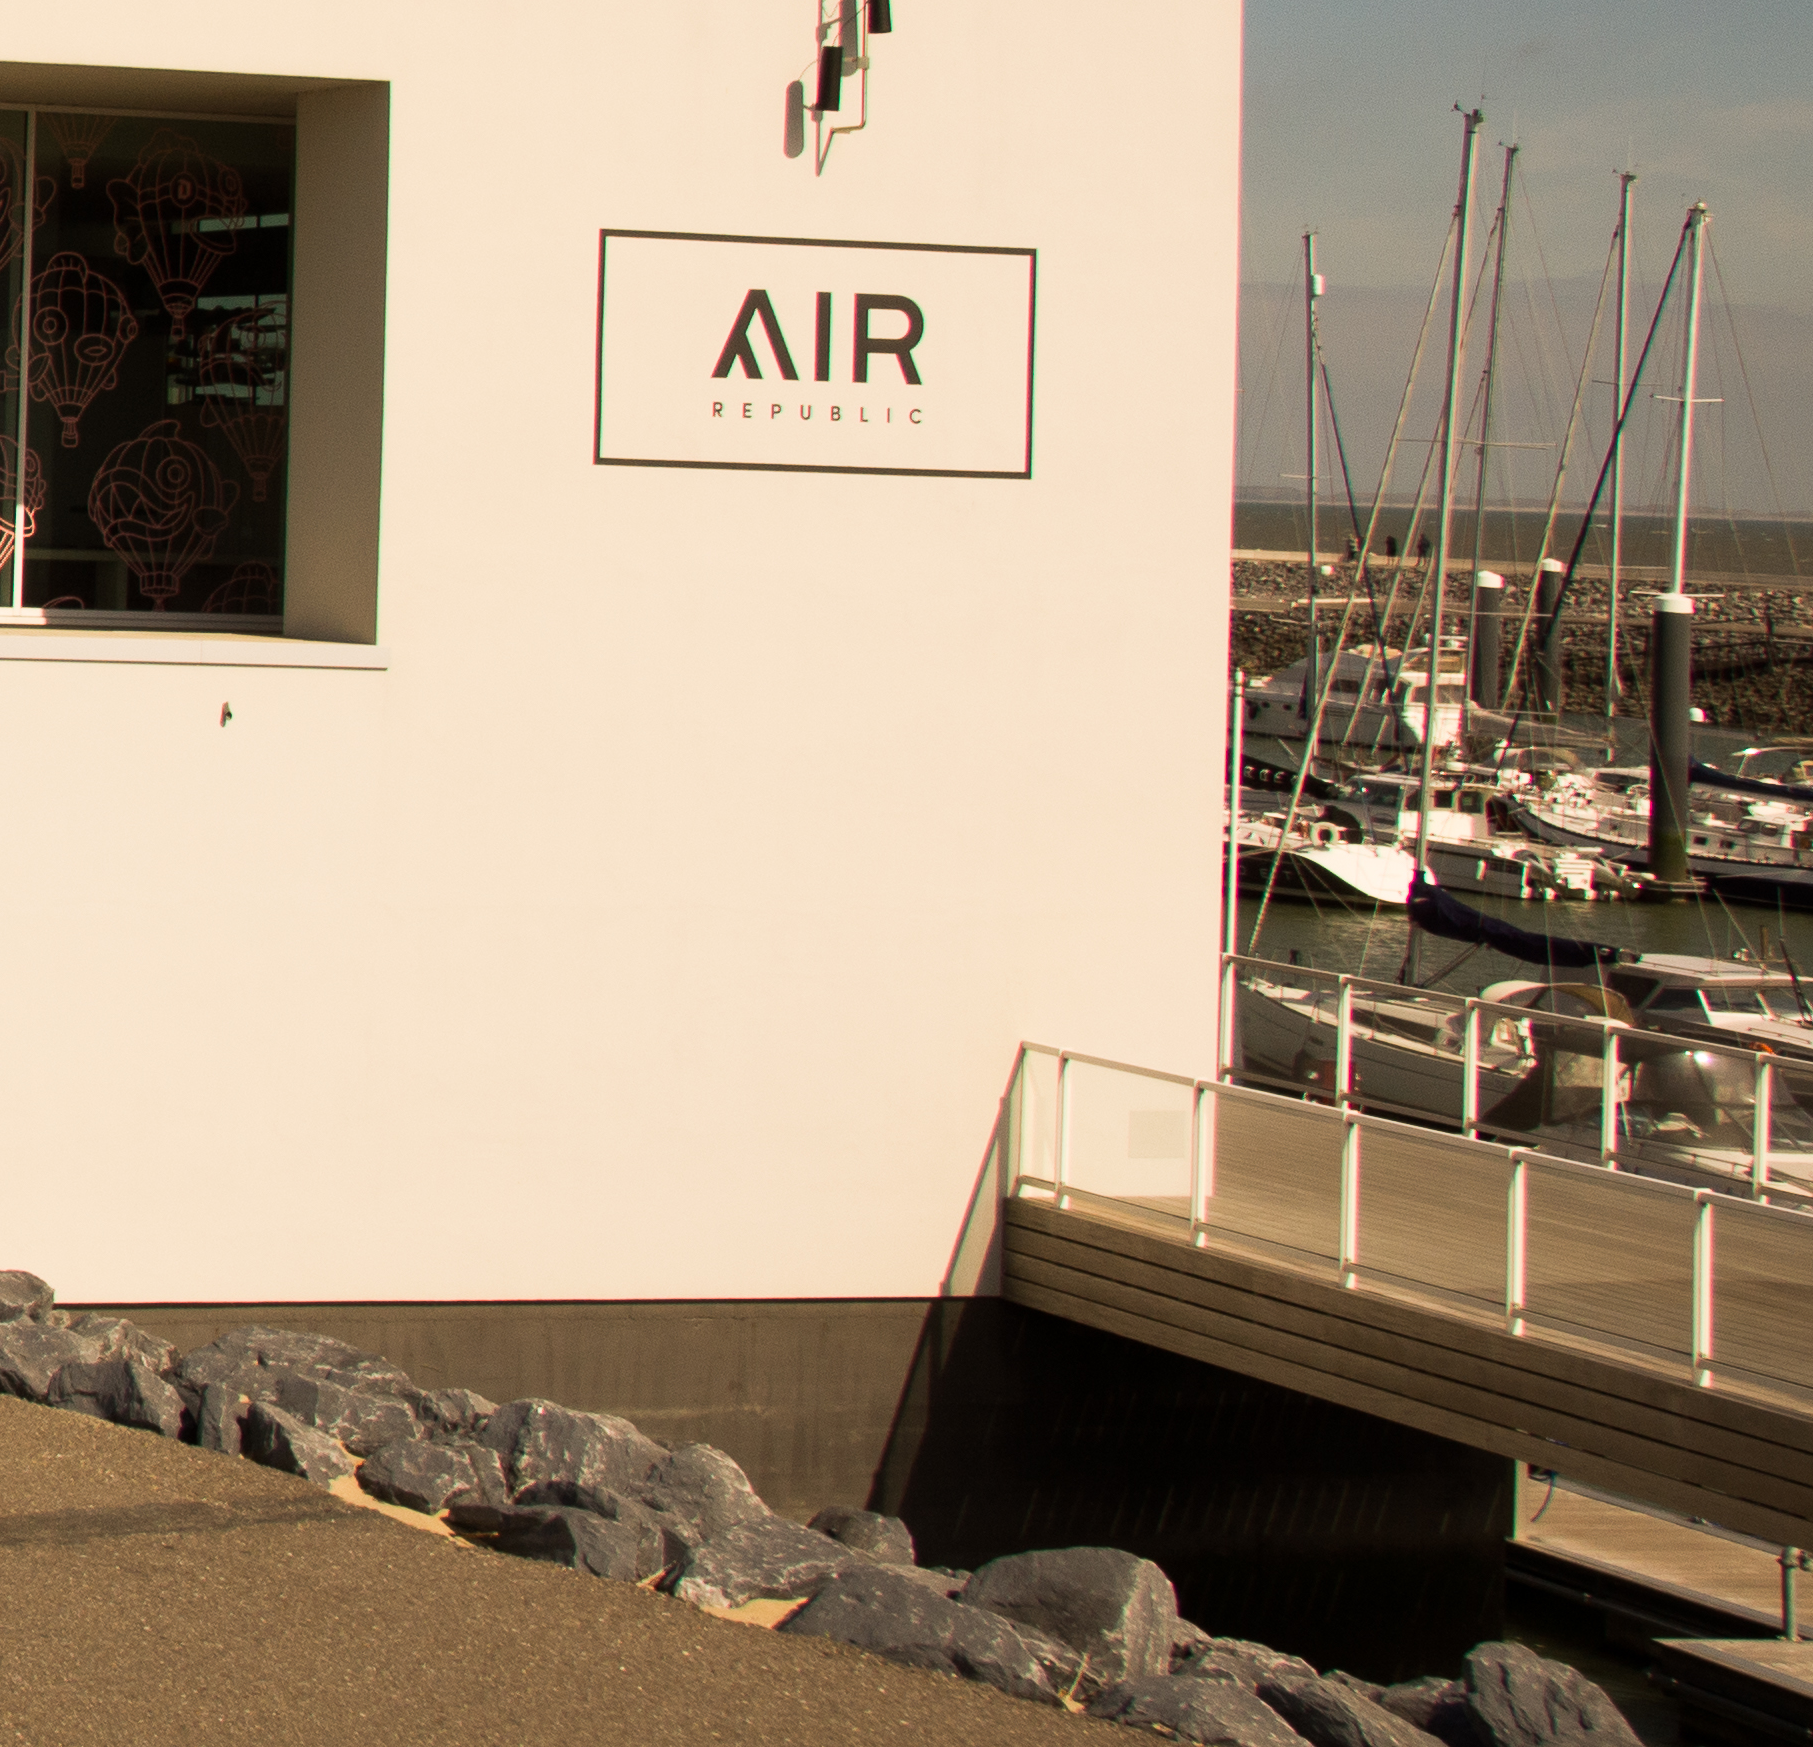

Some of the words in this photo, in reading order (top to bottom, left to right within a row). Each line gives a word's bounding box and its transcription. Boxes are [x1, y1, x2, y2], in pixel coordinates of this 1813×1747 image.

[178, 179, 192, 200] D
[711, 288, 925, 385] AIR
[712, 401, 923, 424] REPUBLIC
